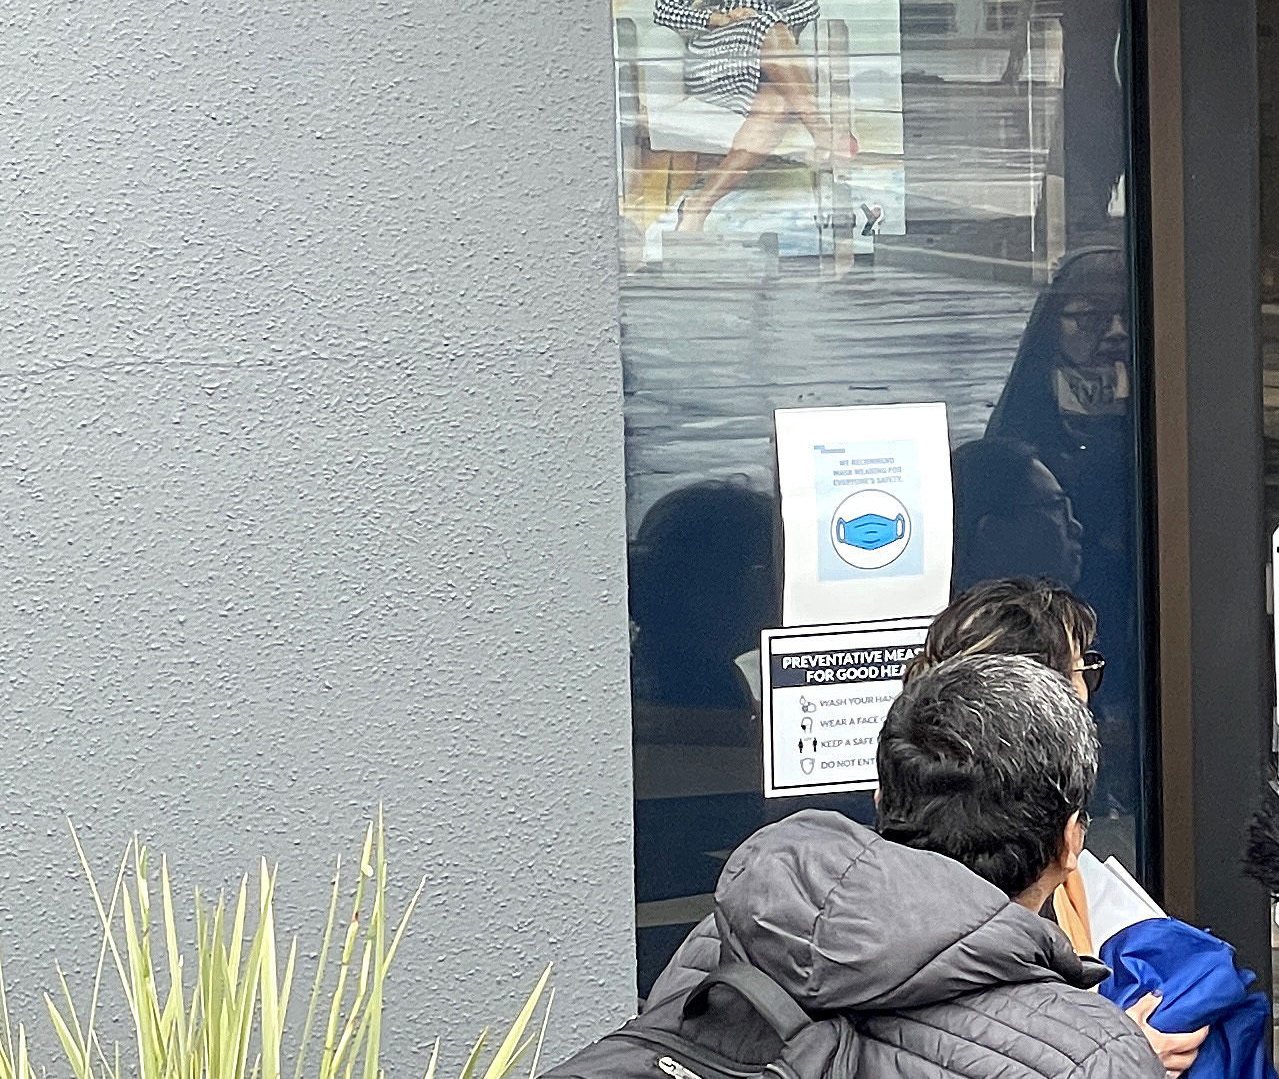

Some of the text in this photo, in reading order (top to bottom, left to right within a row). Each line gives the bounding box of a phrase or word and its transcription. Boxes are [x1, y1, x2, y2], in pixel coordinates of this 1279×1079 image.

[782, 647, 925, 670] PREVENTATIVE MEAS
[806, 664, 907, 683] FOR GOOD HEA
[819, 695, 895, 707] WASH YOUR HAN
[819, 718, 847, 728] WEAR
[856, 716, 880, 725] FACE
[820, 739, 844, 748] KEEP
[853, 737, 874, 746] SAFE
[821, 757, 876, 769] DO NOT ENT
